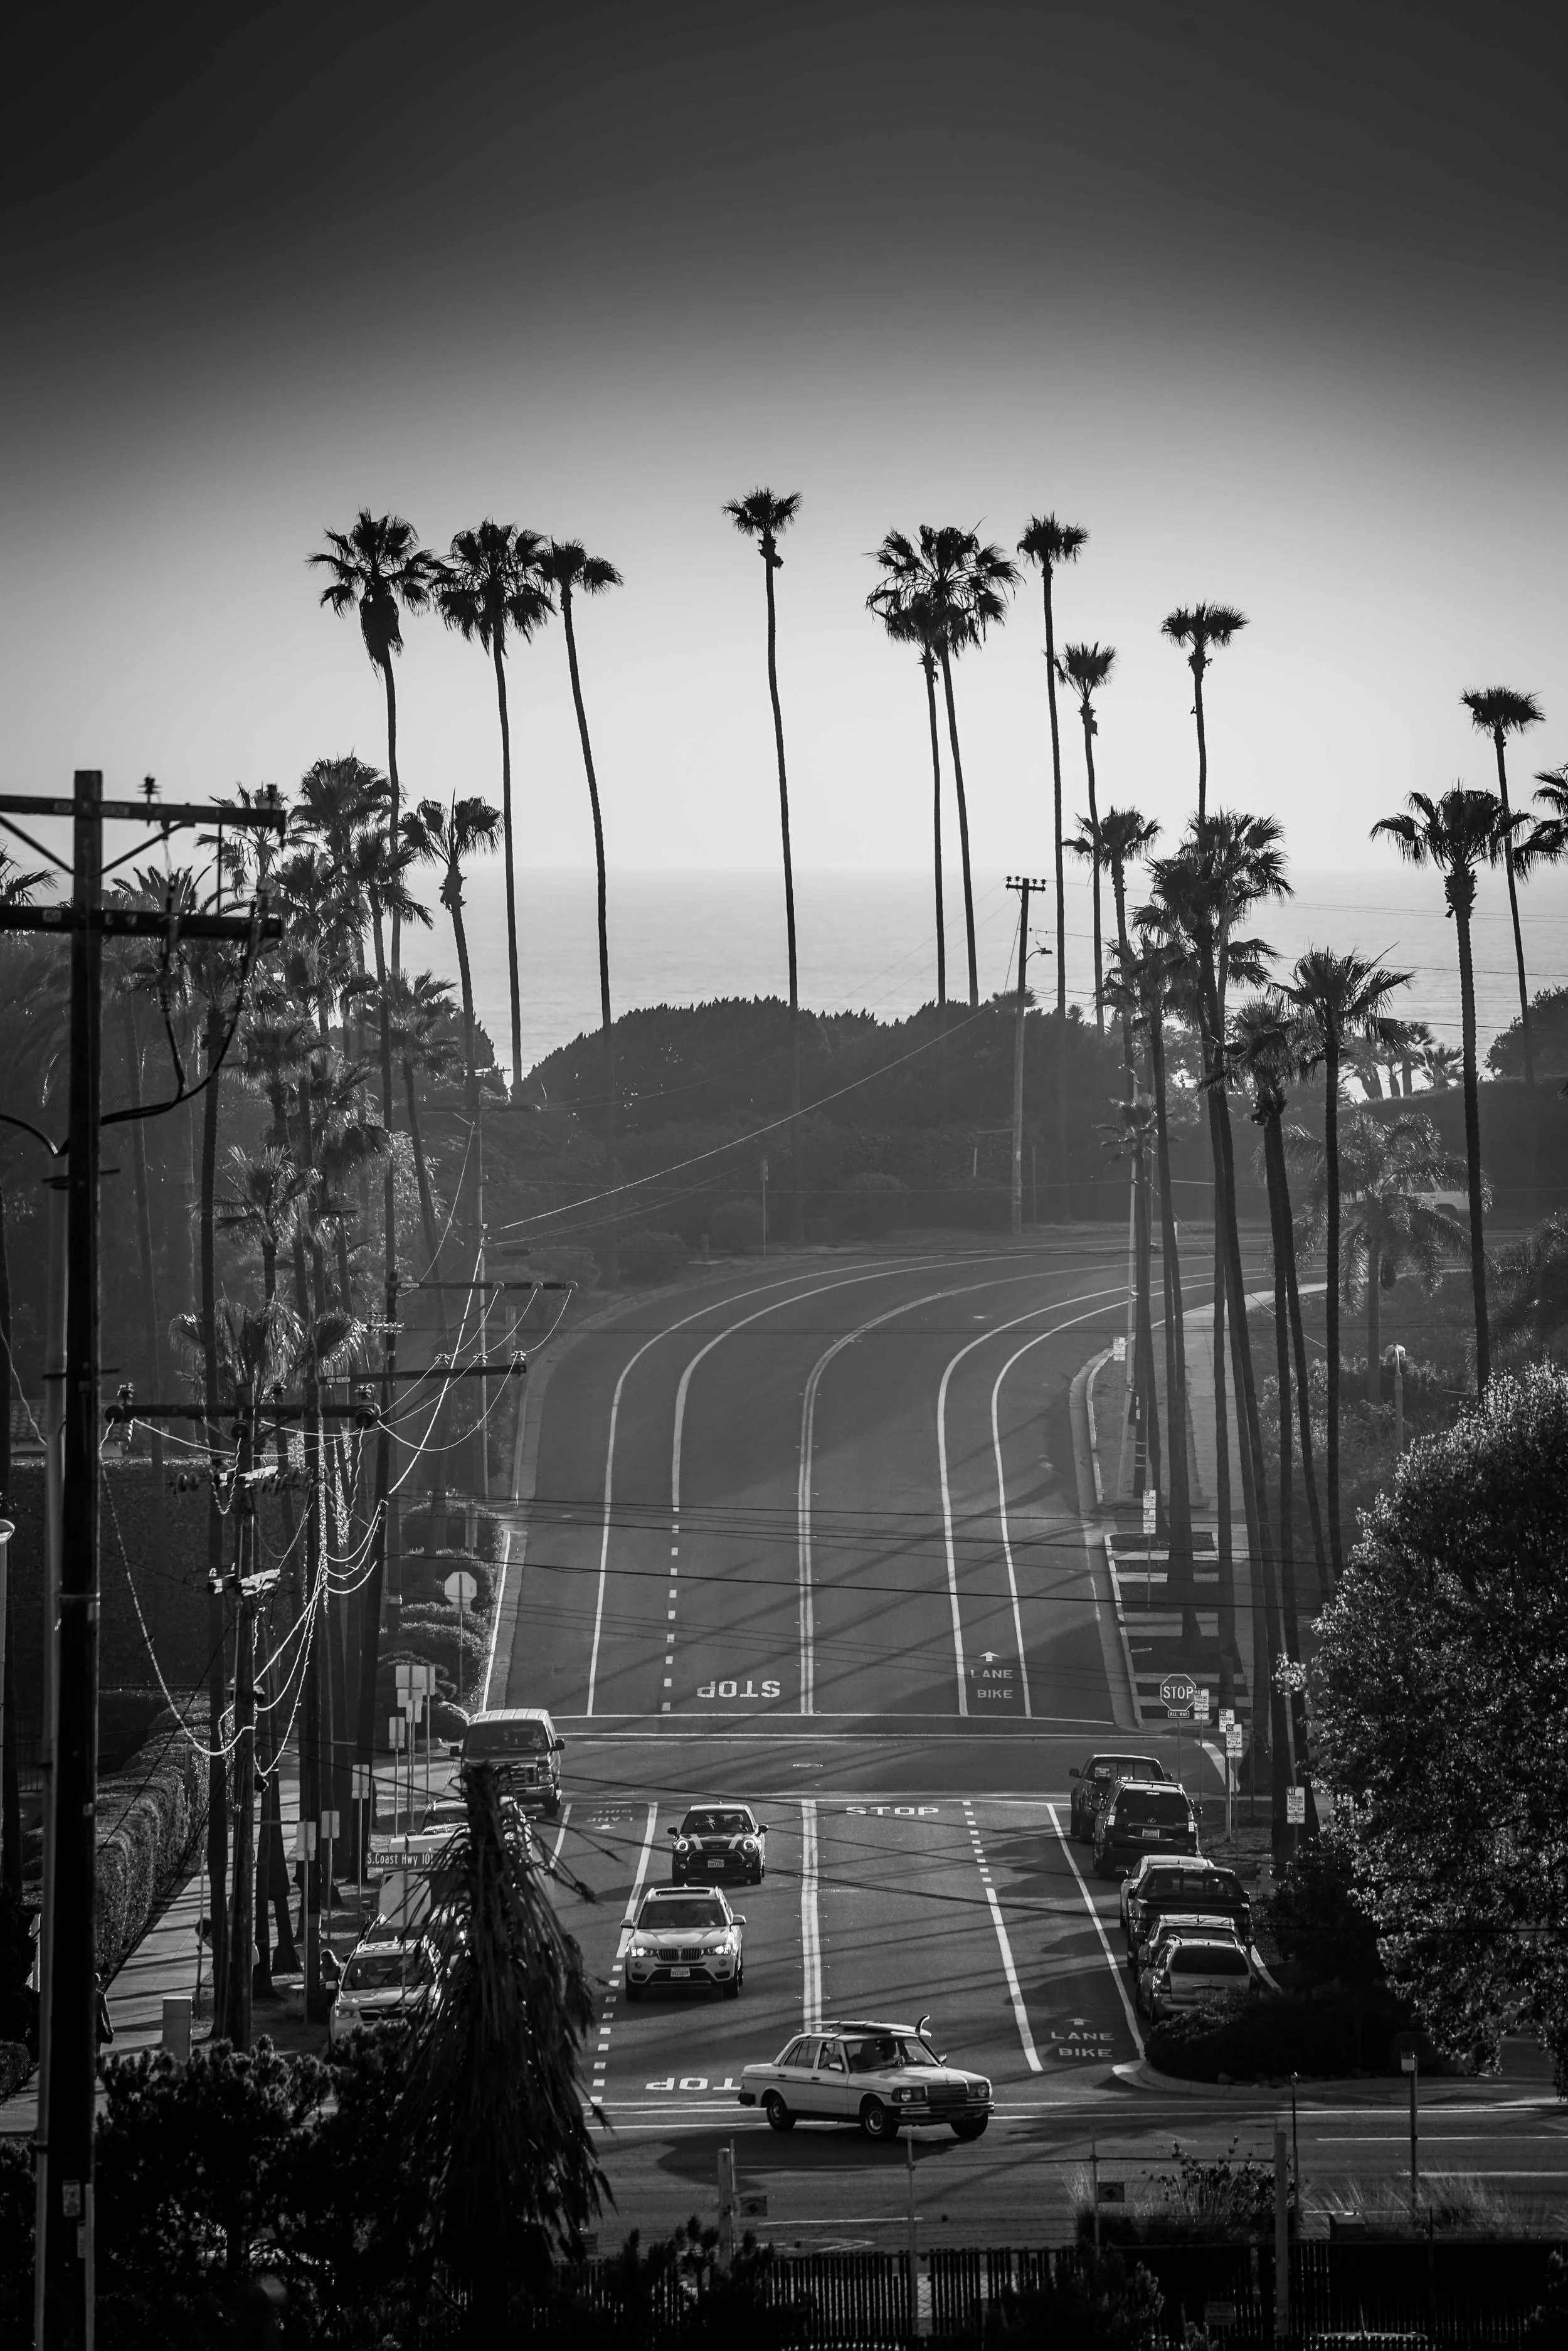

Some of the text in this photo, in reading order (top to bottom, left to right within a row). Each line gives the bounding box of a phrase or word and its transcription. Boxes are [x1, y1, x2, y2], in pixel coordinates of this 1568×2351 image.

[971, 1669, 1013, 1679] LANE
[697, 1680, 780, 1698] STOP
[977, 1689, 1014, 1699] BIKE
[1163, 1686, 1194, 1699] STOP
[846, 1807, 939, 1815] STOP
[367, 1852, 433, 1867] S.Coast Hwy 101
[1051, 2031, 1115, 2041] LANE
[1059, 2048, 1113, 2057] BIKE
[645, 2078, 741, 2091] TOP
